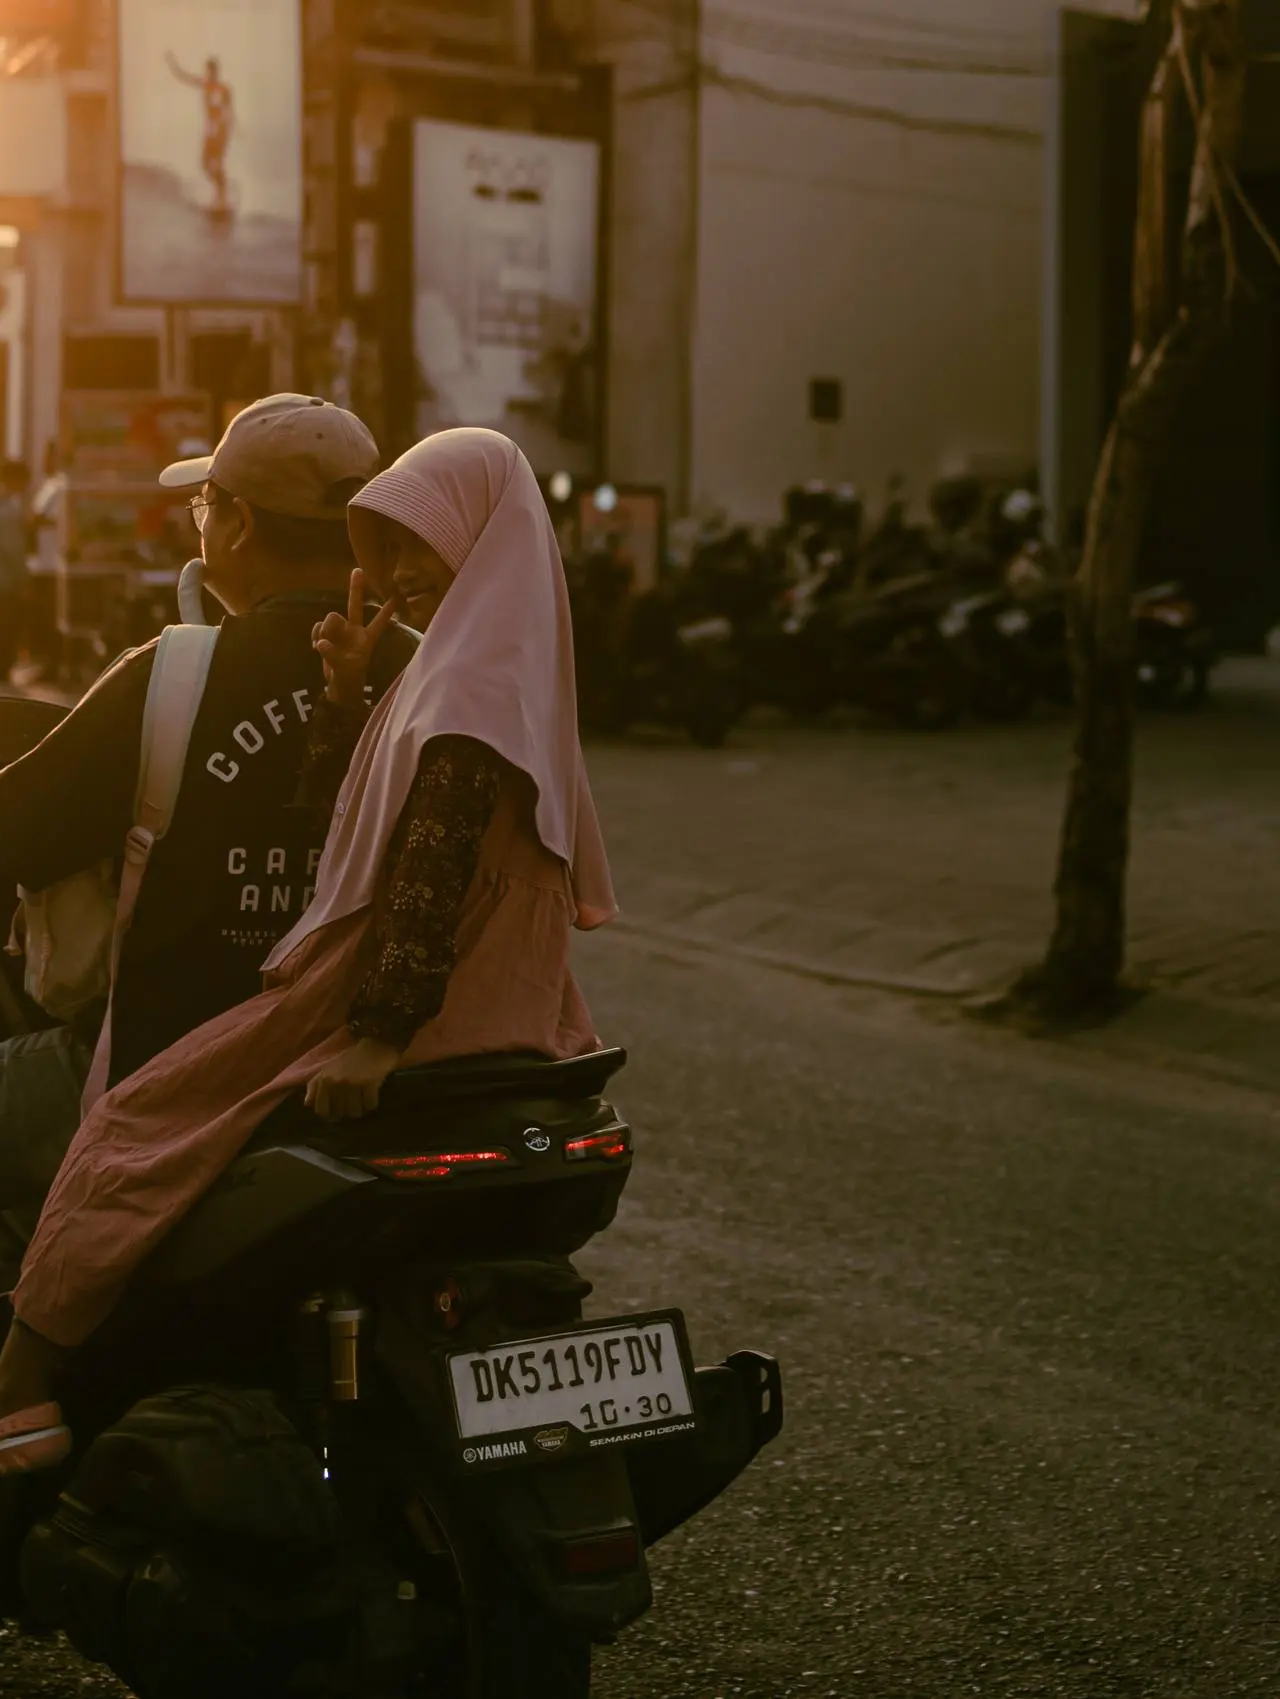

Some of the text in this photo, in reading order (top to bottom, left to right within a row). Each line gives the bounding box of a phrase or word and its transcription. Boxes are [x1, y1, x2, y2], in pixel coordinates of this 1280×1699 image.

[206, 685, 373, 783] COFF
[657, 1421, 696, 1435] DEPAN
[476, 1440, 528, 1461] YAMAHA
